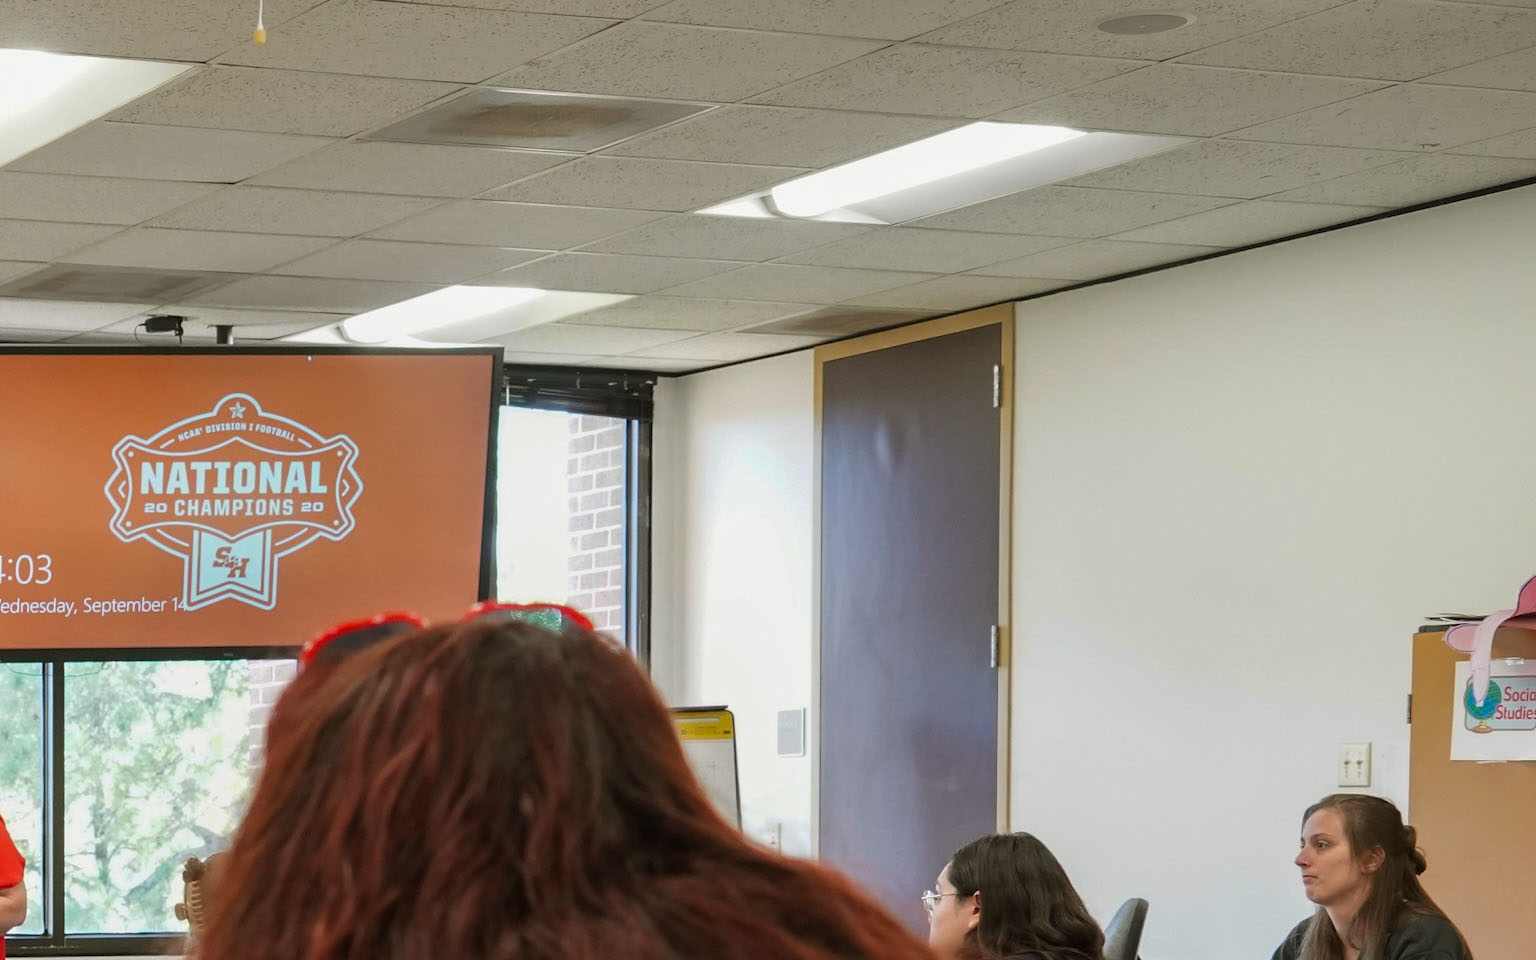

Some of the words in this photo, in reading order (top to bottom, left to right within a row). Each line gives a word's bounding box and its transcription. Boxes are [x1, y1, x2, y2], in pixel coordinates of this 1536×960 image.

[205, 422, 246, 433] DIVISION
[248, 423, 254, 431] I
[255, 424, 295, 441] FOOTBALL
[140, 461, 328, 494] NATIONAL
[144, 502, 167, 513] 20
[174, 499, 294, 516] CHAMPIONS
[301, 502, 324, 512] 20
[83, 597, 167, 616] September
